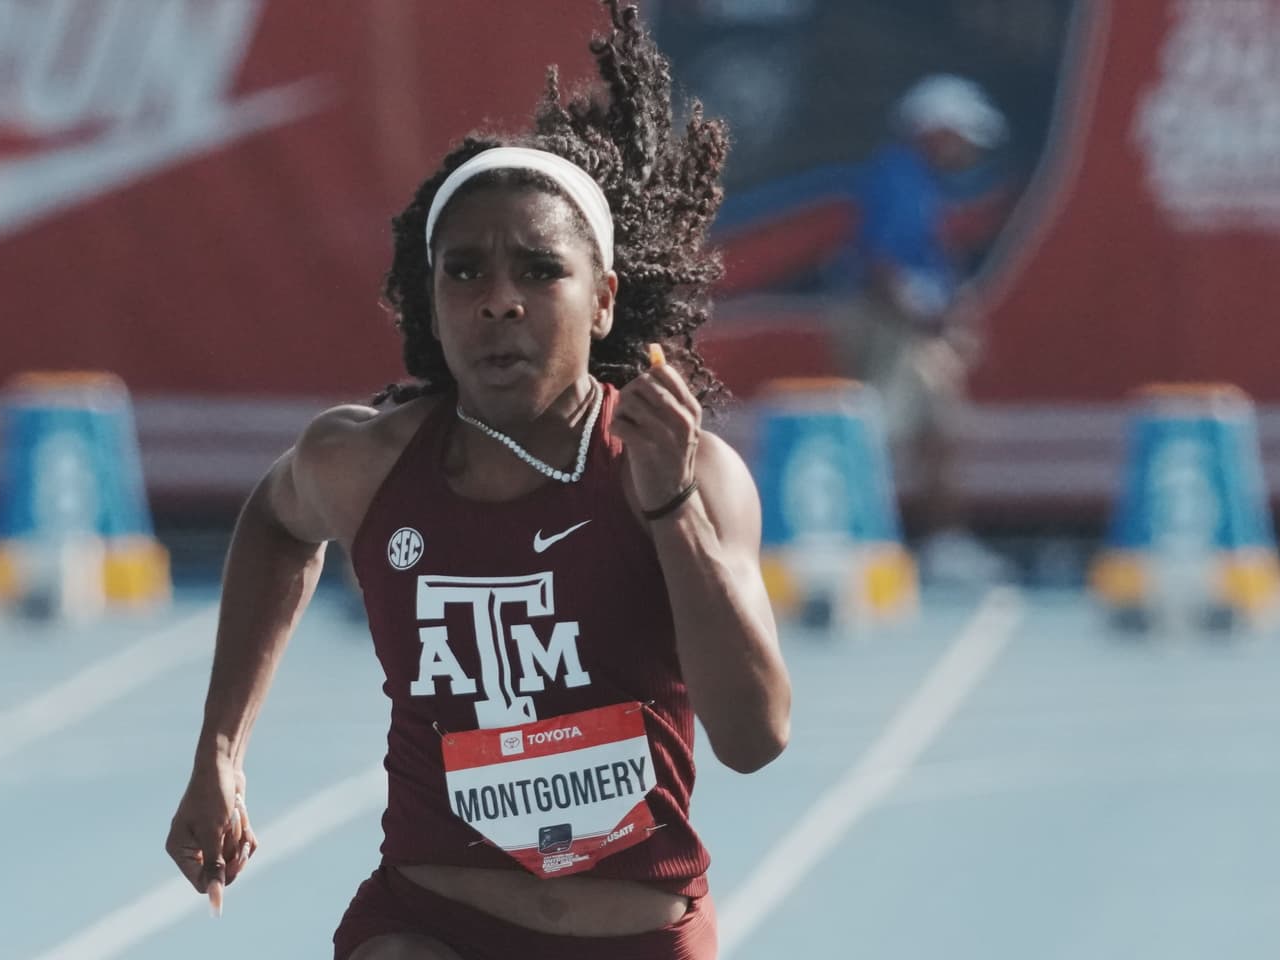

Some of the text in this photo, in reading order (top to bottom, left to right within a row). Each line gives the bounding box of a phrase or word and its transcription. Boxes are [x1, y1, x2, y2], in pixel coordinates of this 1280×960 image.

[388, 528, 424, 569] SEC
[527, 726, 583, 746] TOYOTA
[454, 756, 647, 823] MONTGOMERY
[607, 822, 635, 842] USATF
